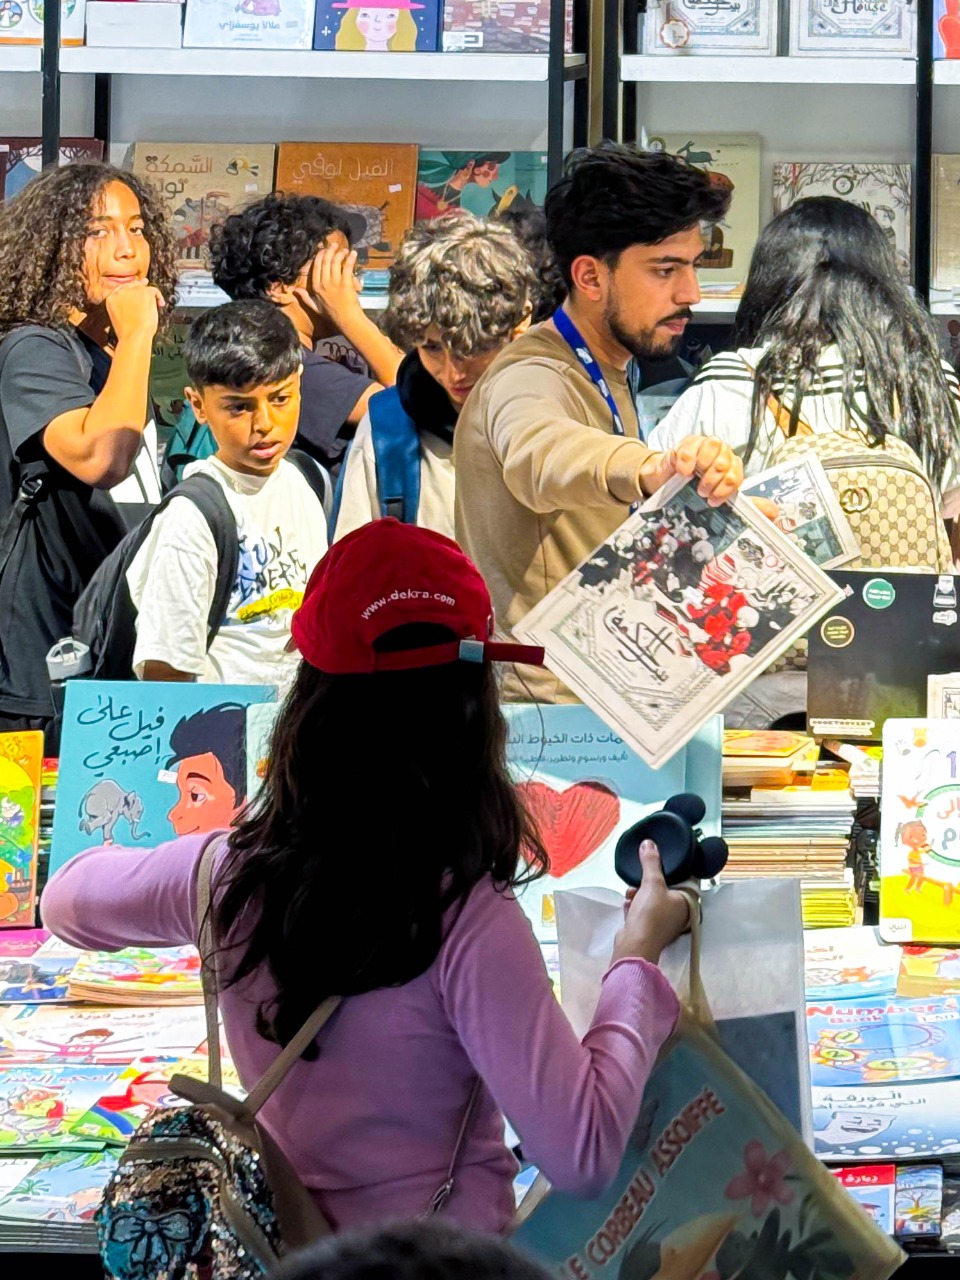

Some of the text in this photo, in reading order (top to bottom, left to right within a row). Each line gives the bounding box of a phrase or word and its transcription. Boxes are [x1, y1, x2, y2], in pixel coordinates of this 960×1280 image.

[361, 588, 456, 620] www.dekra.com
[109, 706, 165, 741] فيل
[587, 1169, 656, 1266] CORBEAU
